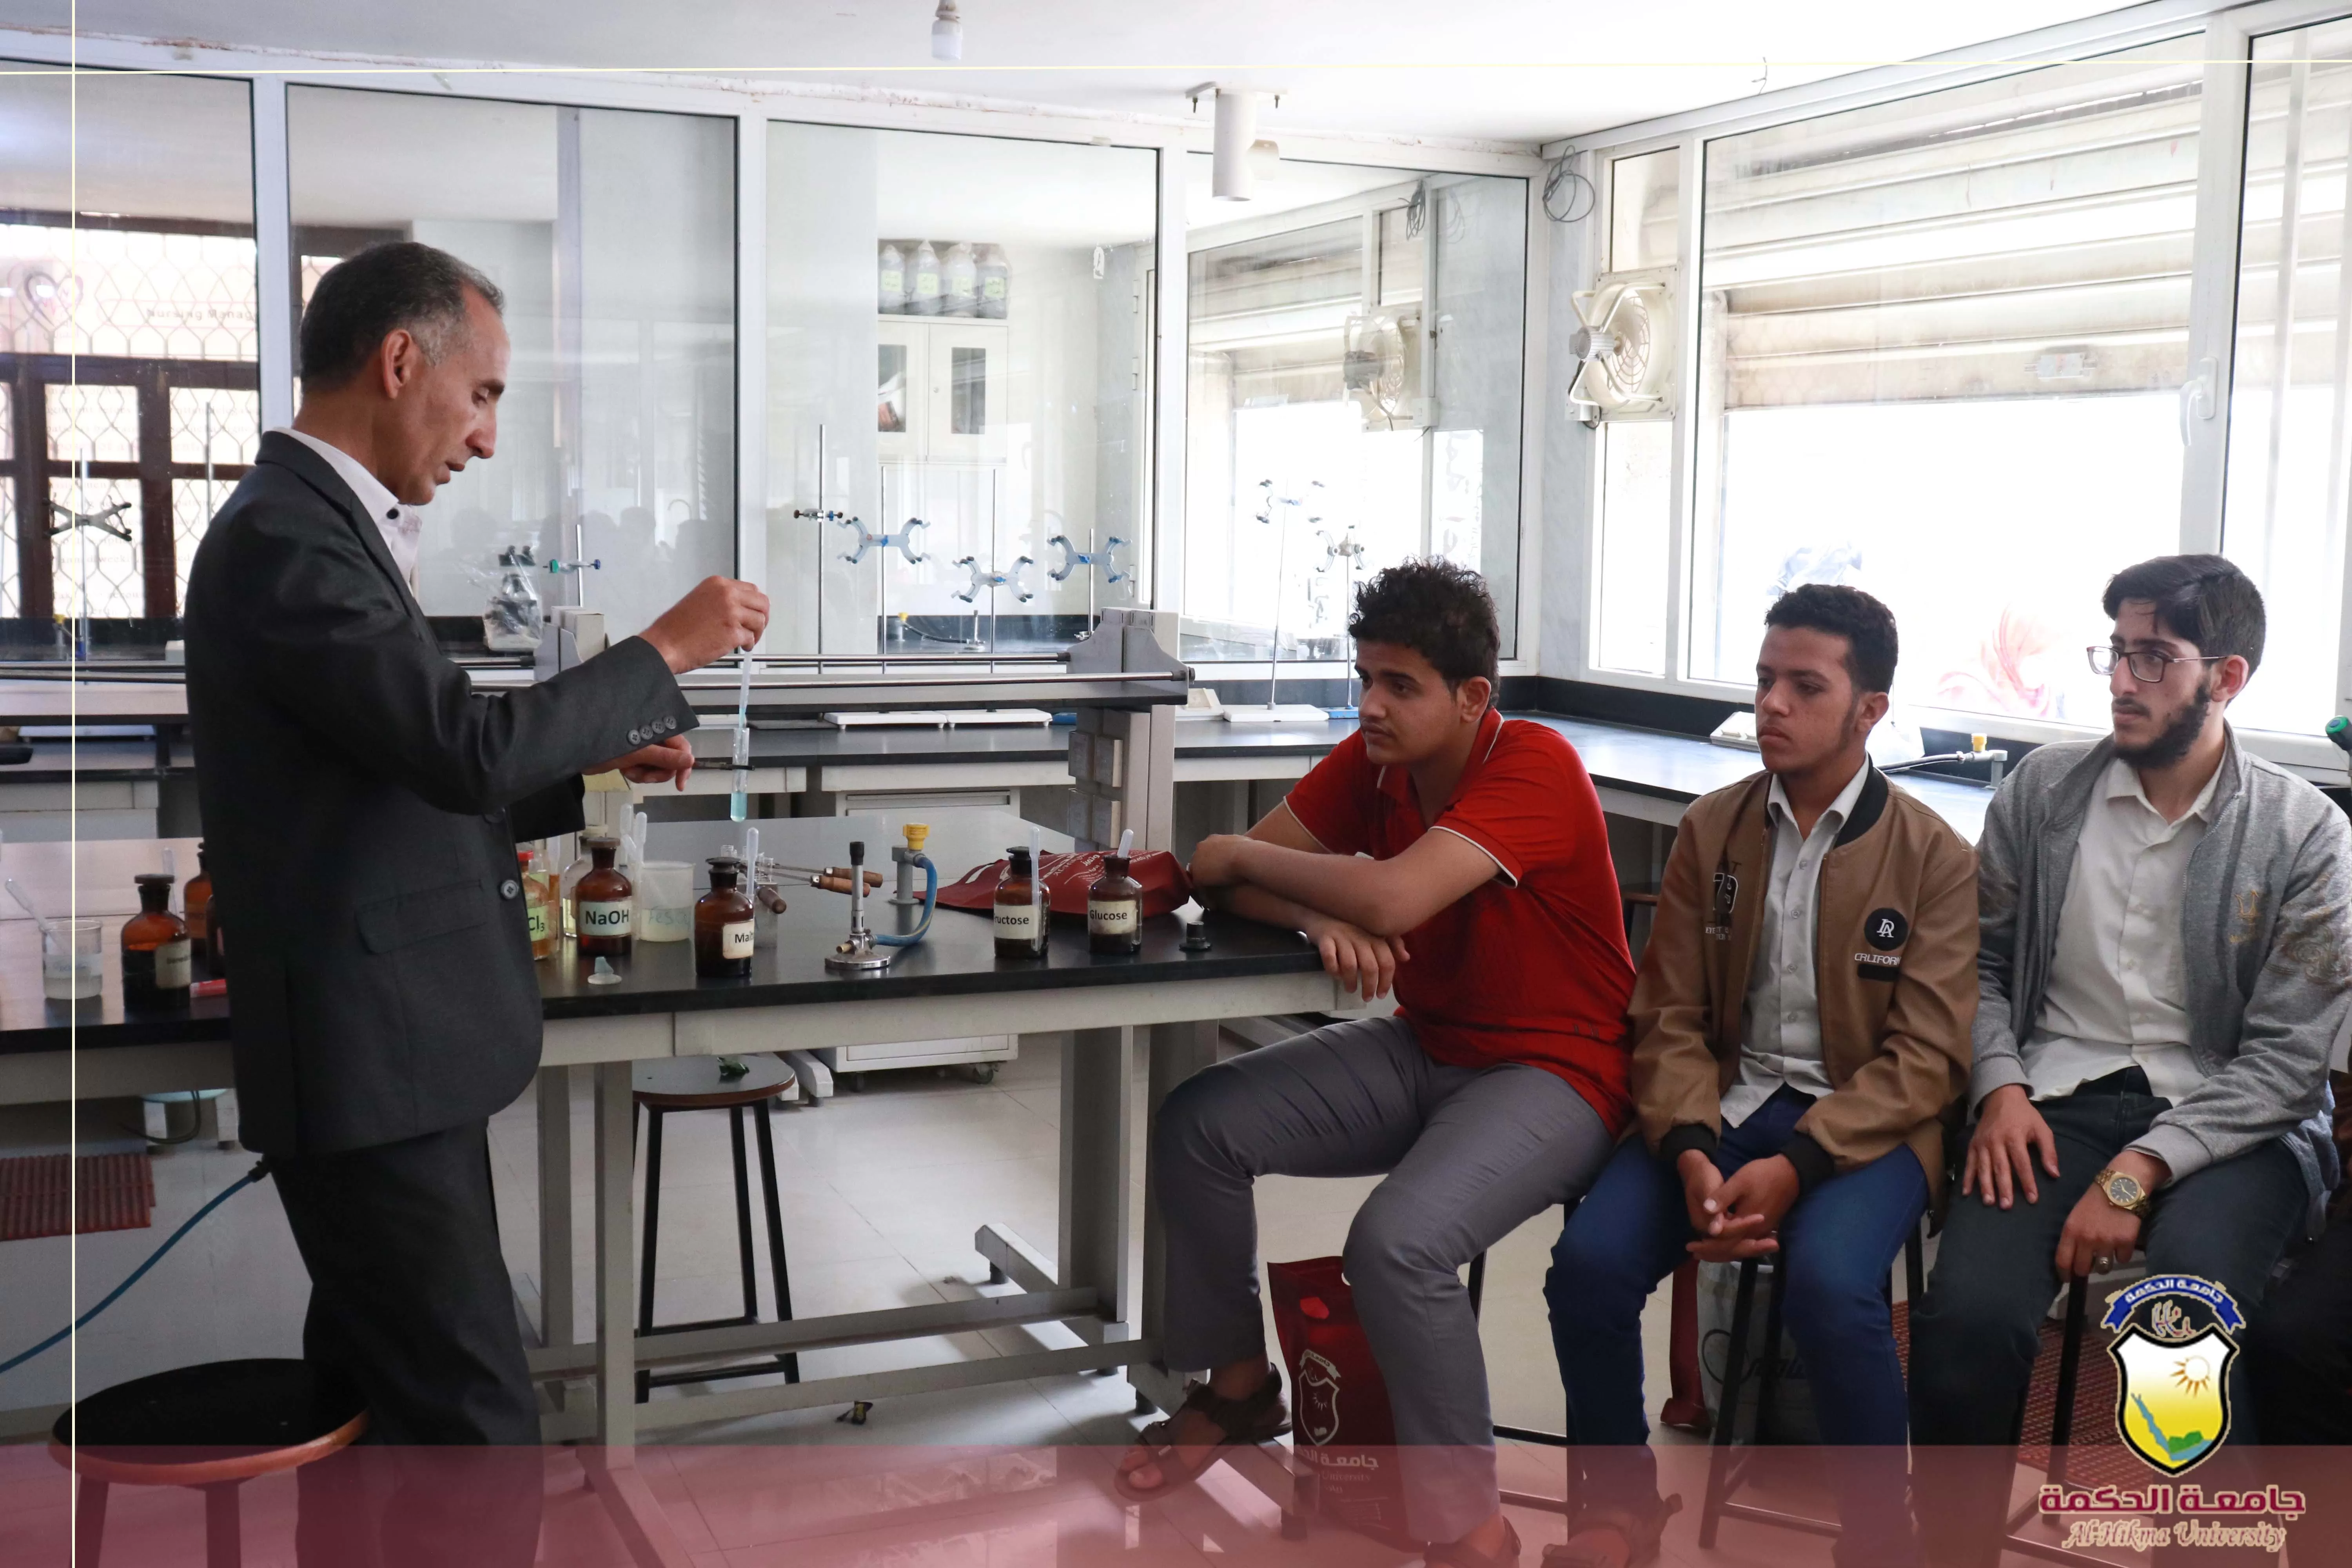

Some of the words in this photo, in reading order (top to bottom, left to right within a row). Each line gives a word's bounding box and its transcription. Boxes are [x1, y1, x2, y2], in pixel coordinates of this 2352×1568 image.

[585, 909, 629, 925] NaOH
[994, 913, 1029, 925] ructose
[1090, 909, 1128, 920] Glucose
[1320, 1452, 1379, 1471] جامعة
